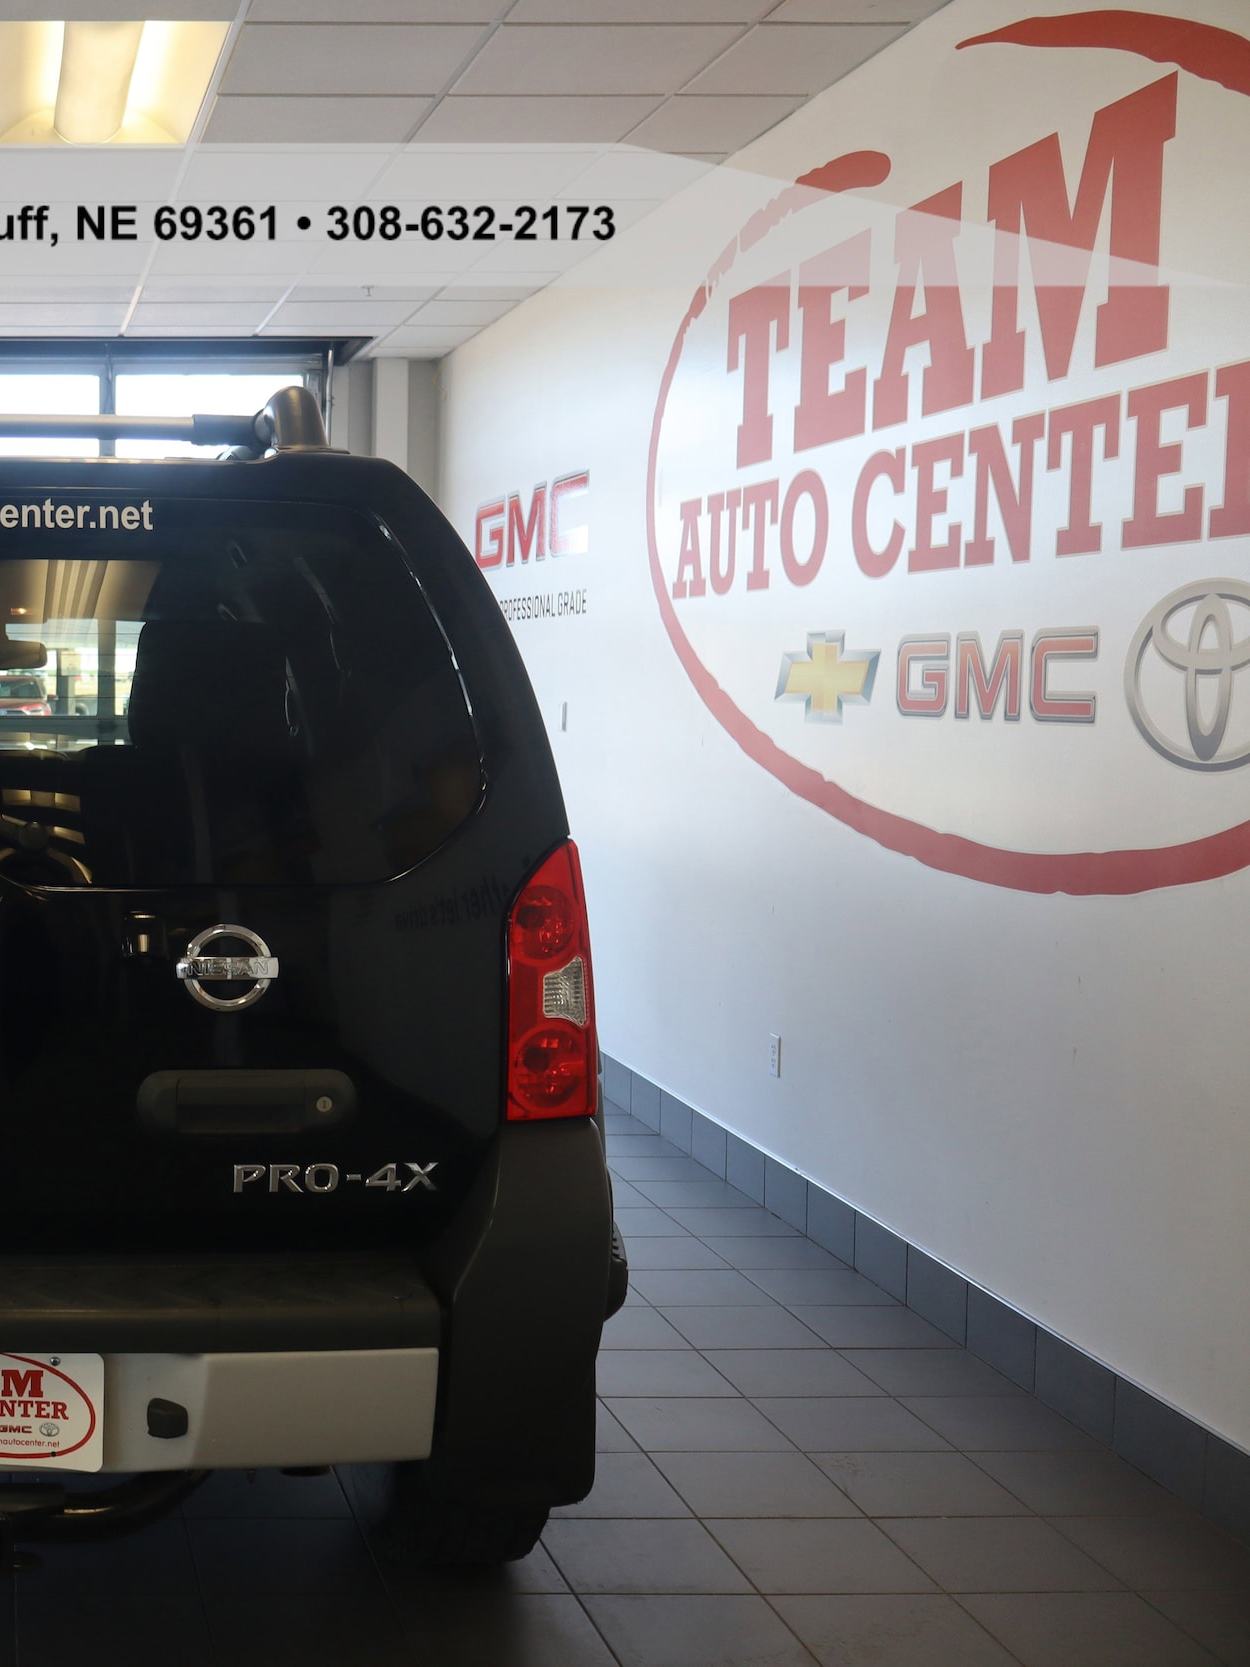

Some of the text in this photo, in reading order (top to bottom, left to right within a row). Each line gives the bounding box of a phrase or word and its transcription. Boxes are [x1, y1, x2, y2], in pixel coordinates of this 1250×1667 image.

[726, 70, 1178, 470] TEAM
[475, 468, 590, 572] GMC
[672, 466, 830, 600] AUTO
[557, 588, 588, 617] GRADE
[896, 625, 1100, 725] GMC
[233, 1162, 439, 1194] PRO-4X
